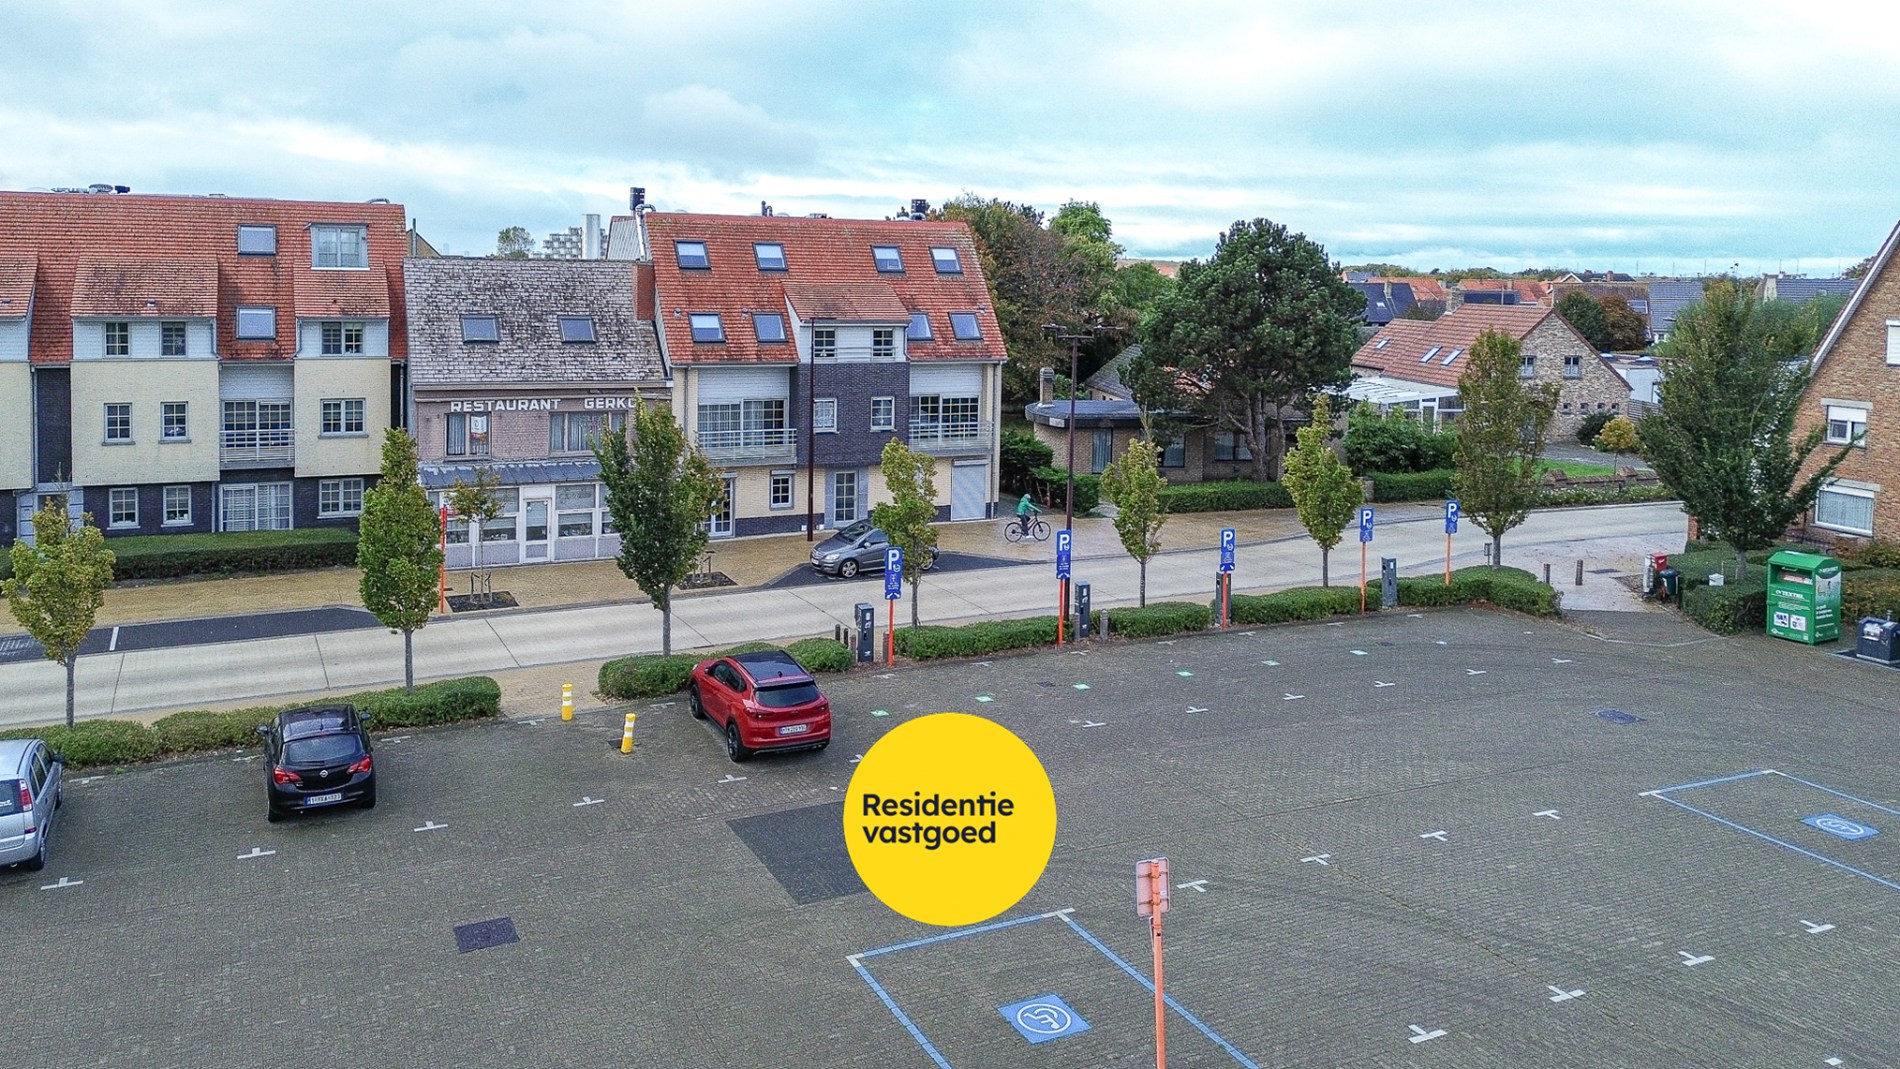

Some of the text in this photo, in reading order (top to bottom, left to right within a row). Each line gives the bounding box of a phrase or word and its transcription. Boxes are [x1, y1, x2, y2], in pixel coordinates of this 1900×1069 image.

[450, 398, 561, 412] RESTAURANT
[1363, 510, 1372, 526] P
[1447, 503, 1457, 518] P
[1059, 534, 1070, 551] P
[1223, 531, 1233, 547] P
[888, 549, 899, 570] P
